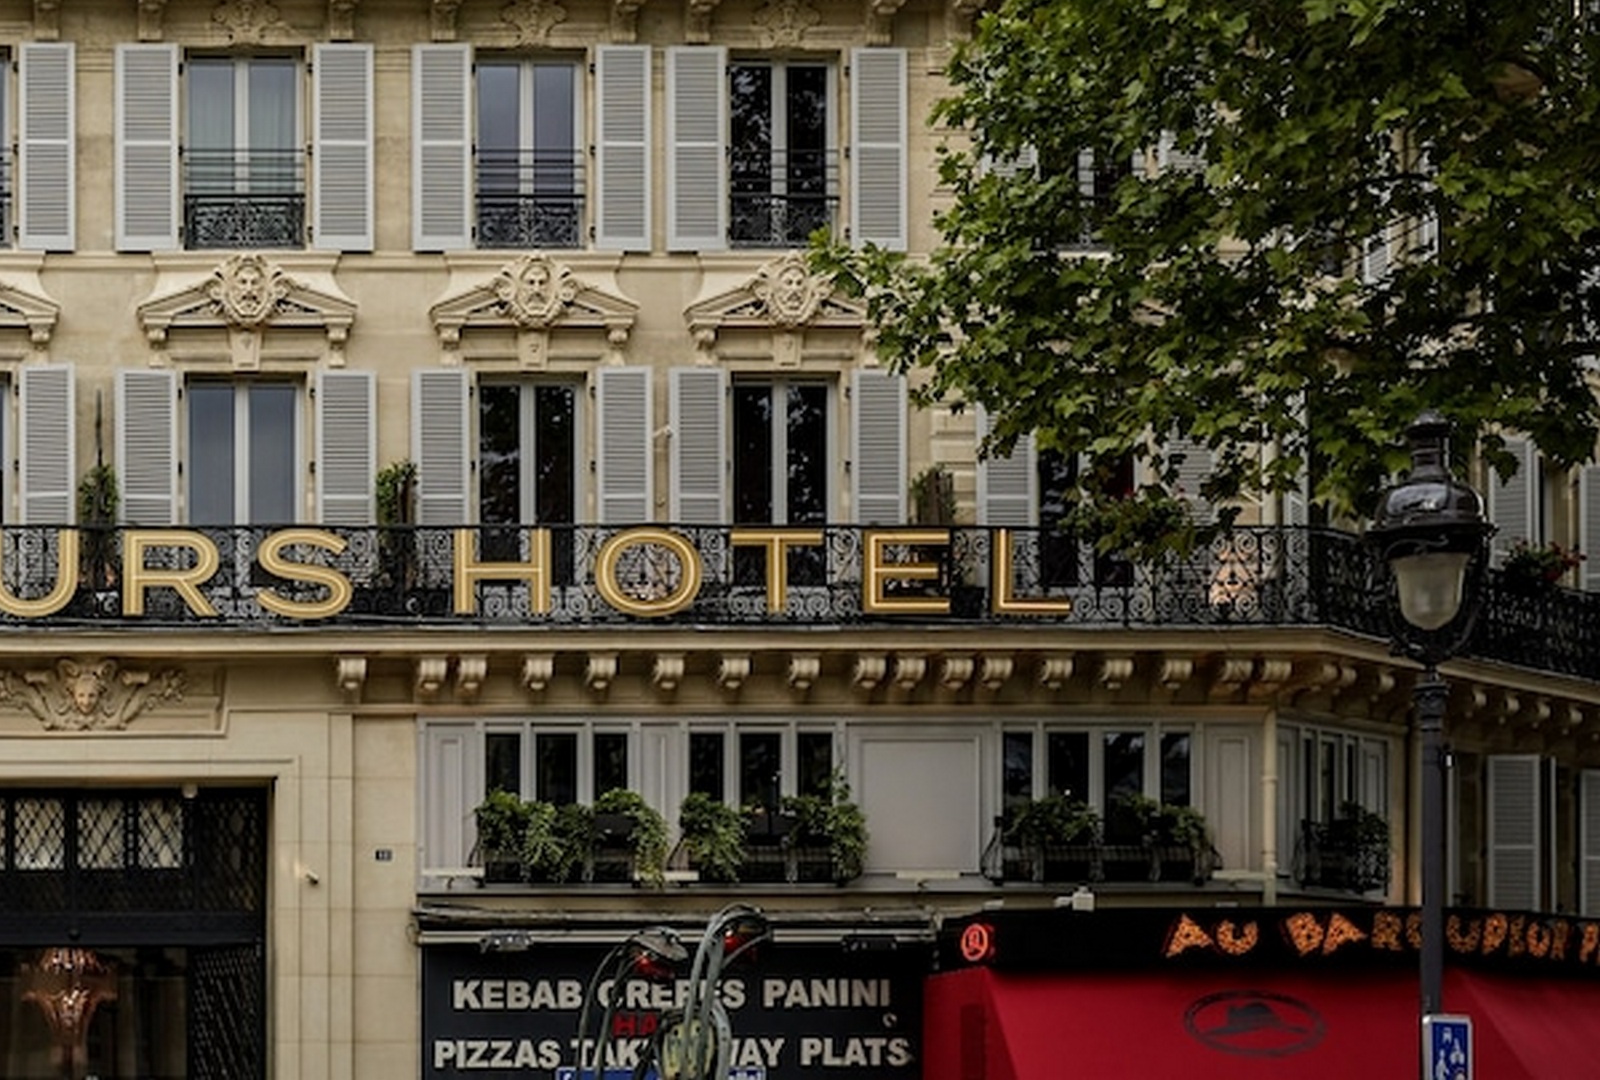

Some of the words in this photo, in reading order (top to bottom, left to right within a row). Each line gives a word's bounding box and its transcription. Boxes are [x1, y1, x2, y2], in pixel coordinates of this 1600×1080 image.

[453, 527, 1071, 617] HOTEL
[1166, 913, 1258, 957] AU
[453, 980, 582, 1009] KEBAB
[763, 979, 890, 1008] PANINI
[434, 1039, 561, 1068] PIZZAS
[801, 1037, 909, 1067] PLATS
